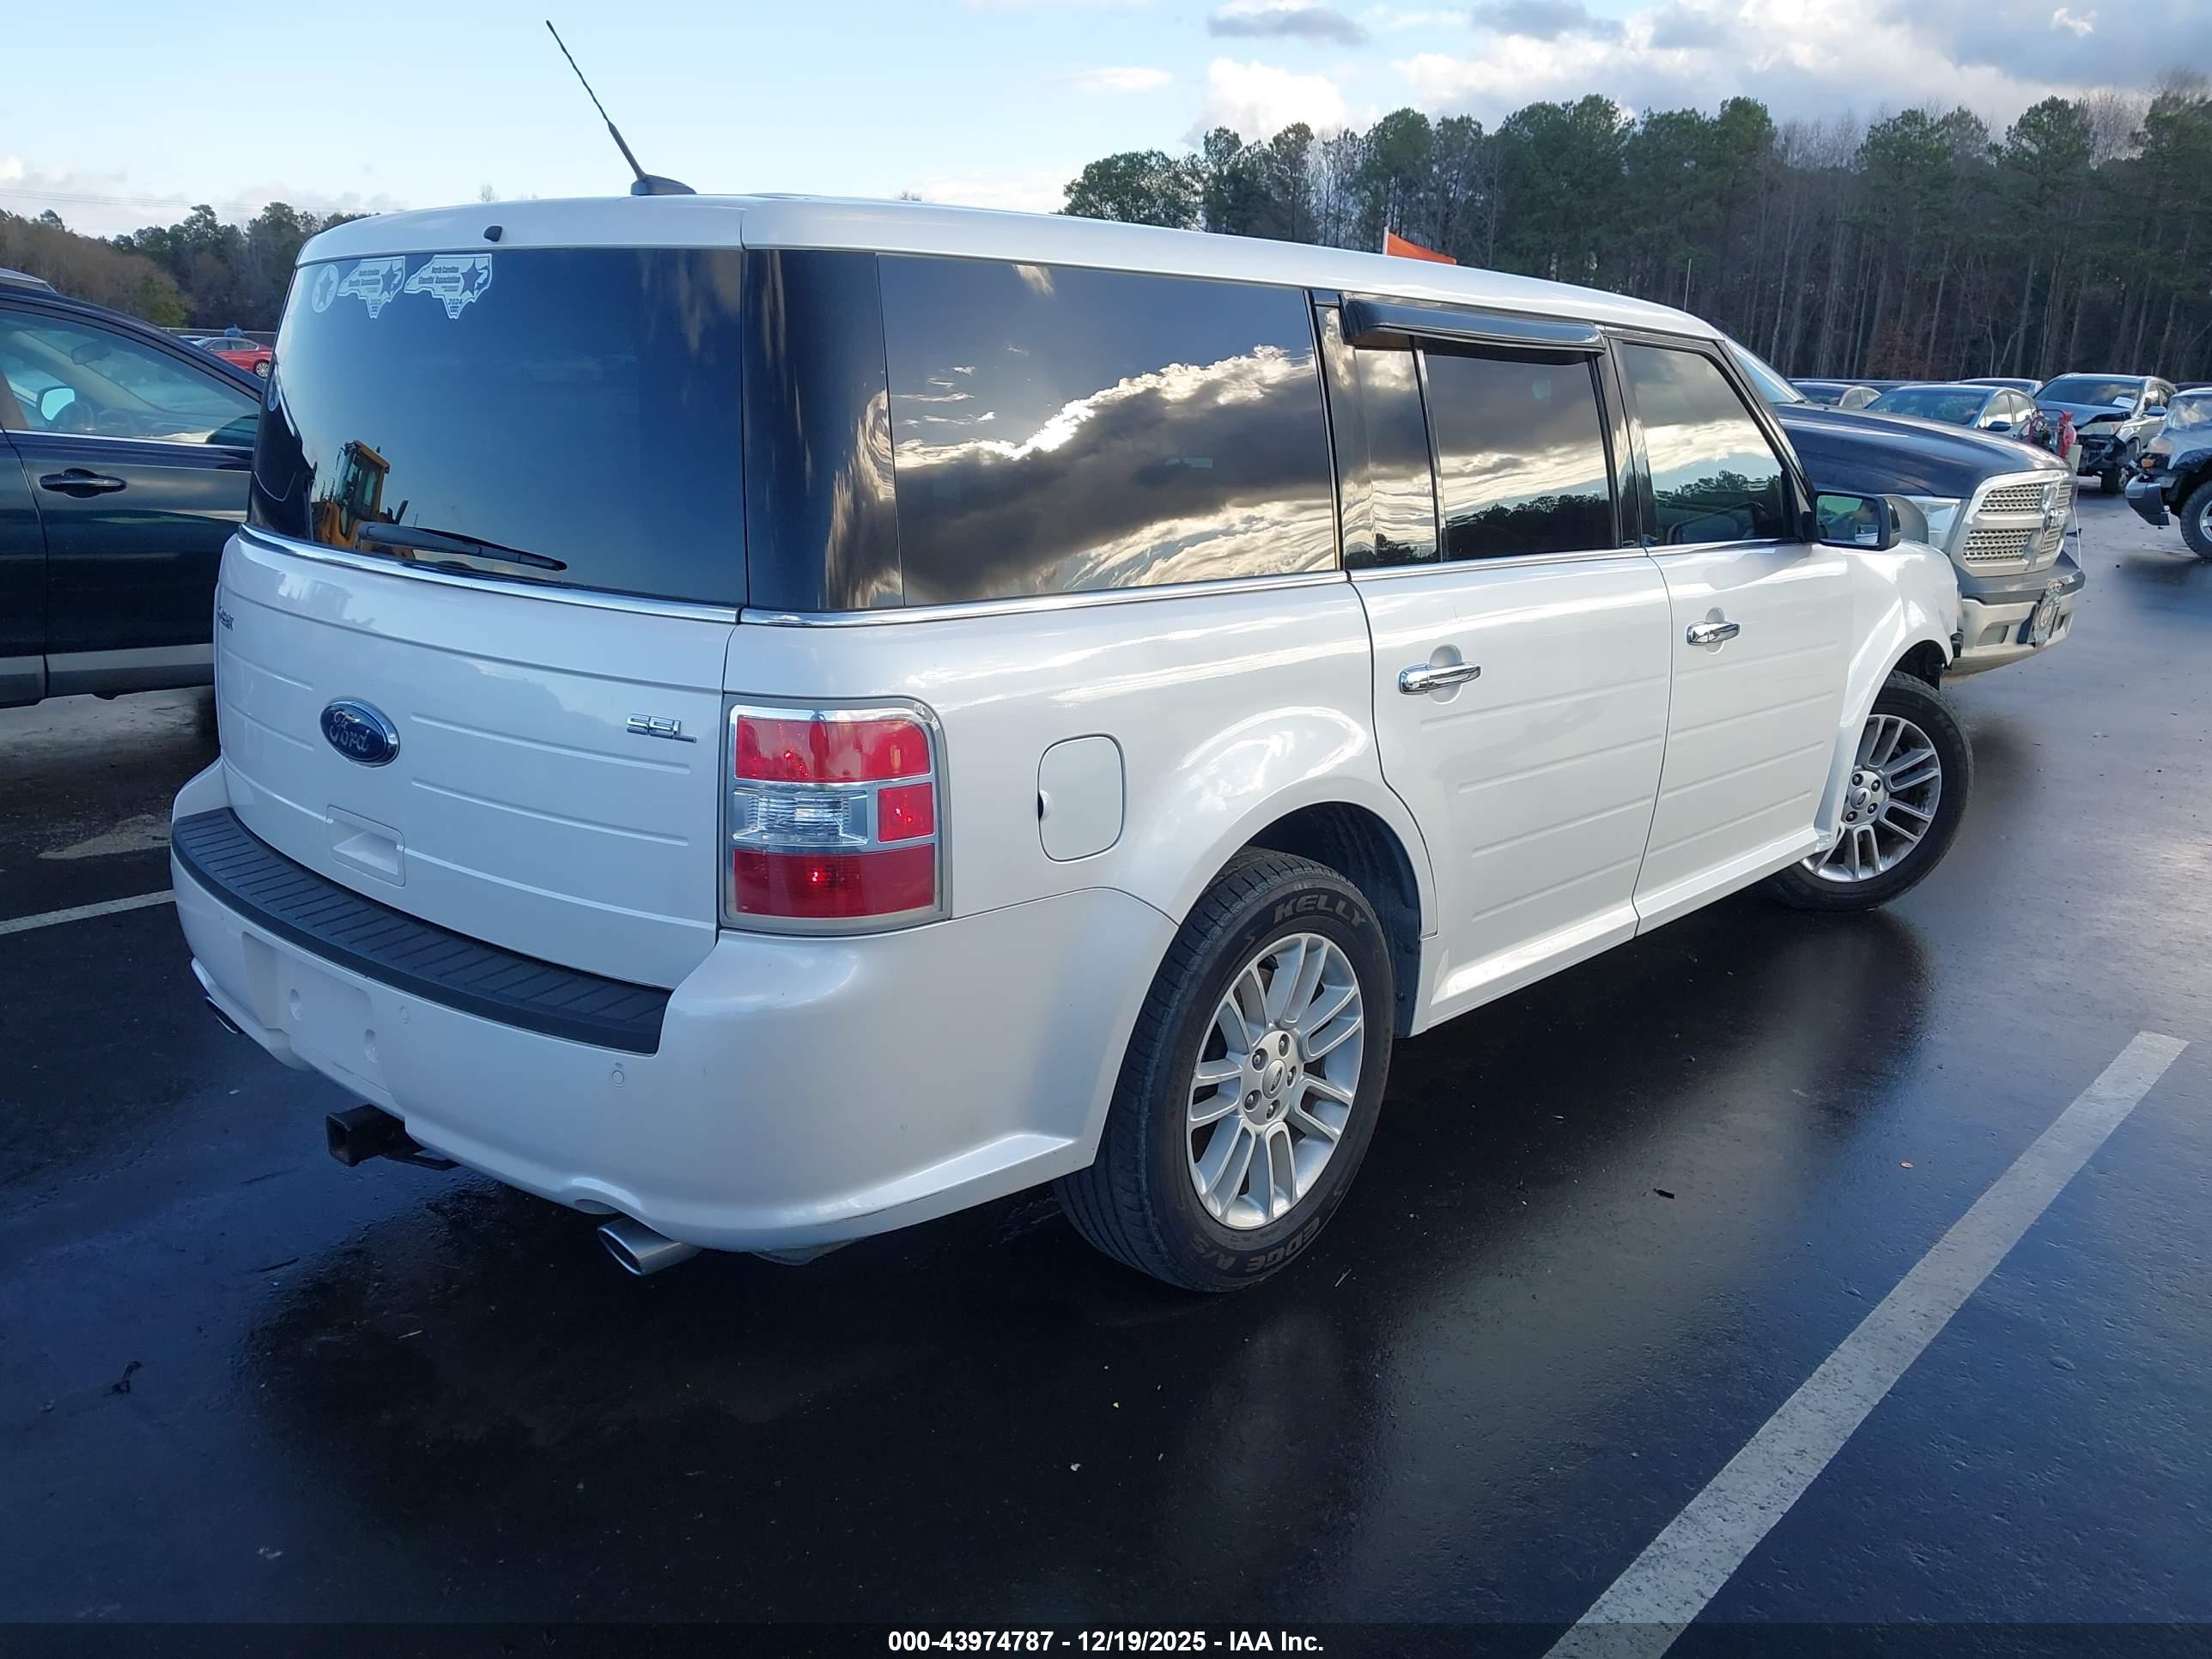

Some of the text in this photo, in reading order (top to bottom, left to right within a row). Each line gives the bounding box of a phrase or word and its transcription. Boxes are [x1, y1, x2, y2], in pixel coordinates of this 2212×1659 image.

[330, 710, 370, 752] Ford
[626, 713, 697, 744] SEL
[1273, 893, 1367, 928] KELLY
[1246, 1216, 1321, 1273] EDGE
